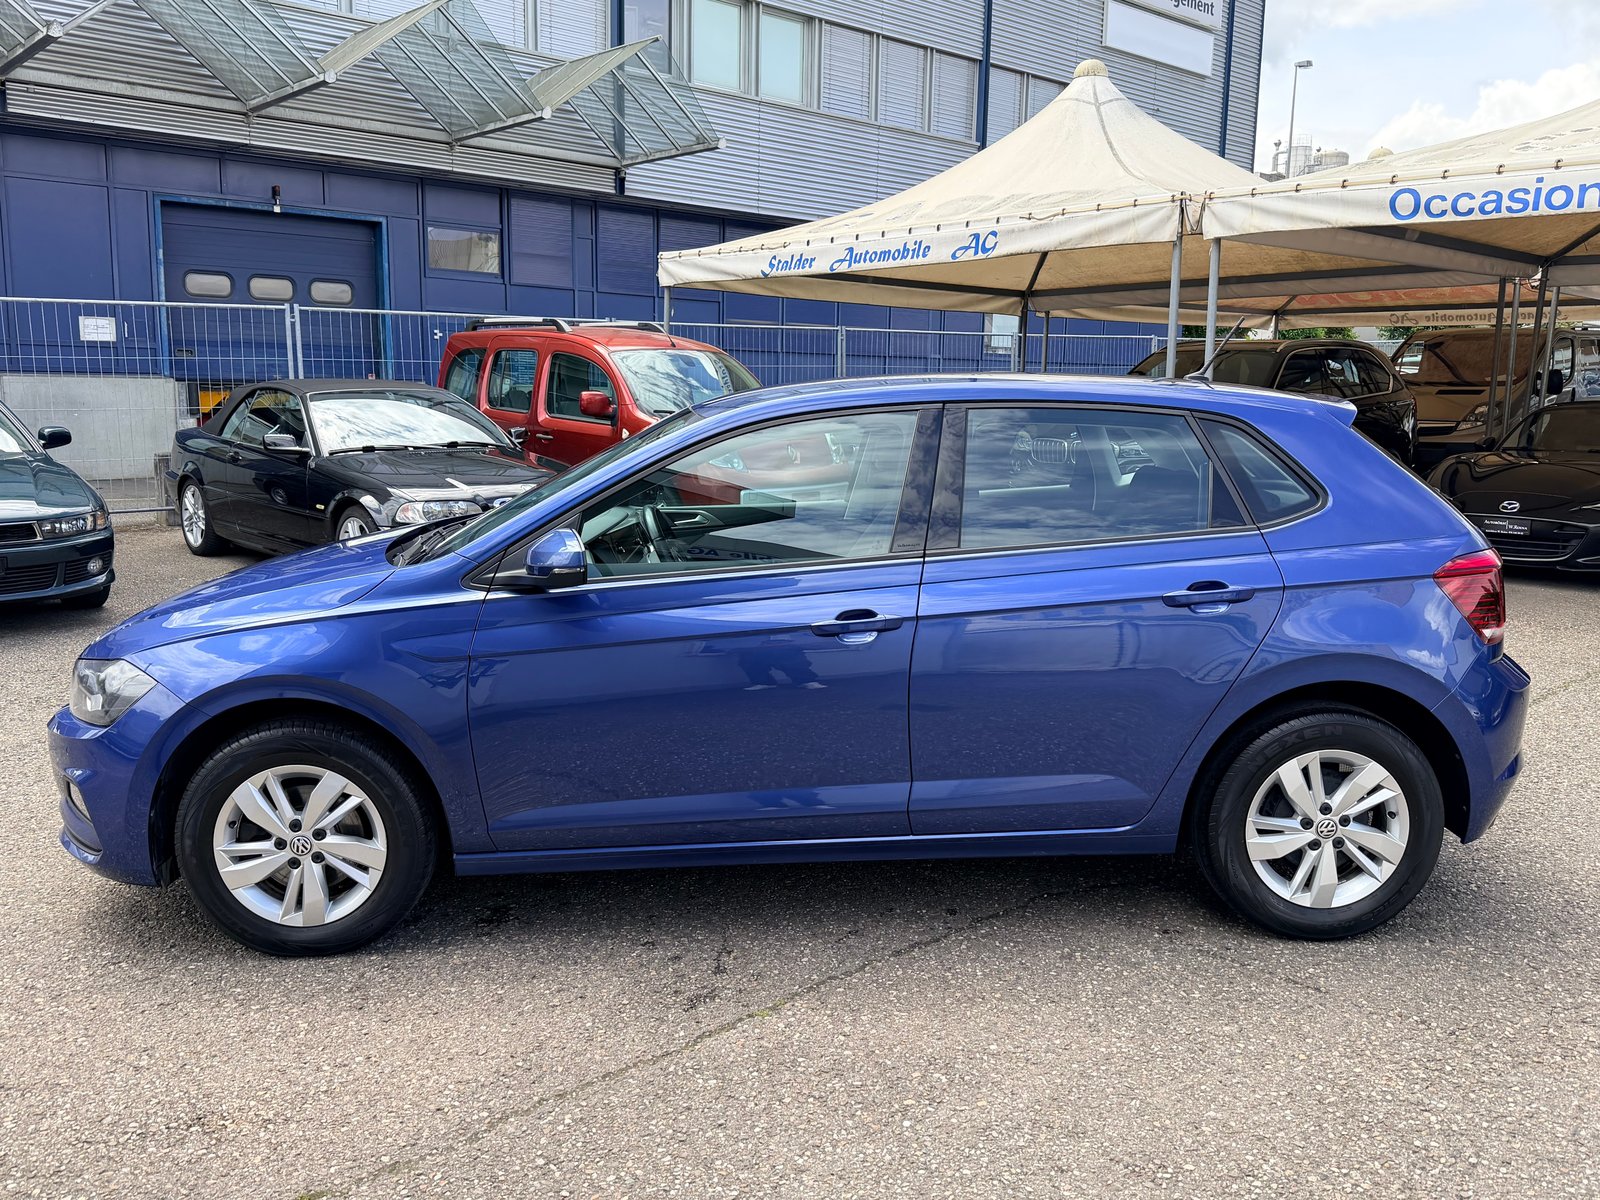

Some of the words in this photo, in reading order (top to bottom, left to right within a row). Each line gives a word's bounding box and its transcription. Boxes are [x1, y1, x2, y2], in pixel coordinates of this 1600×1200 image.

[1170, 0, 1215, 16] gement
[760, 252, 816, 278] Stalder
[829, 239, 932, 273] Automobile
[950, 229, 999, 261] AG
